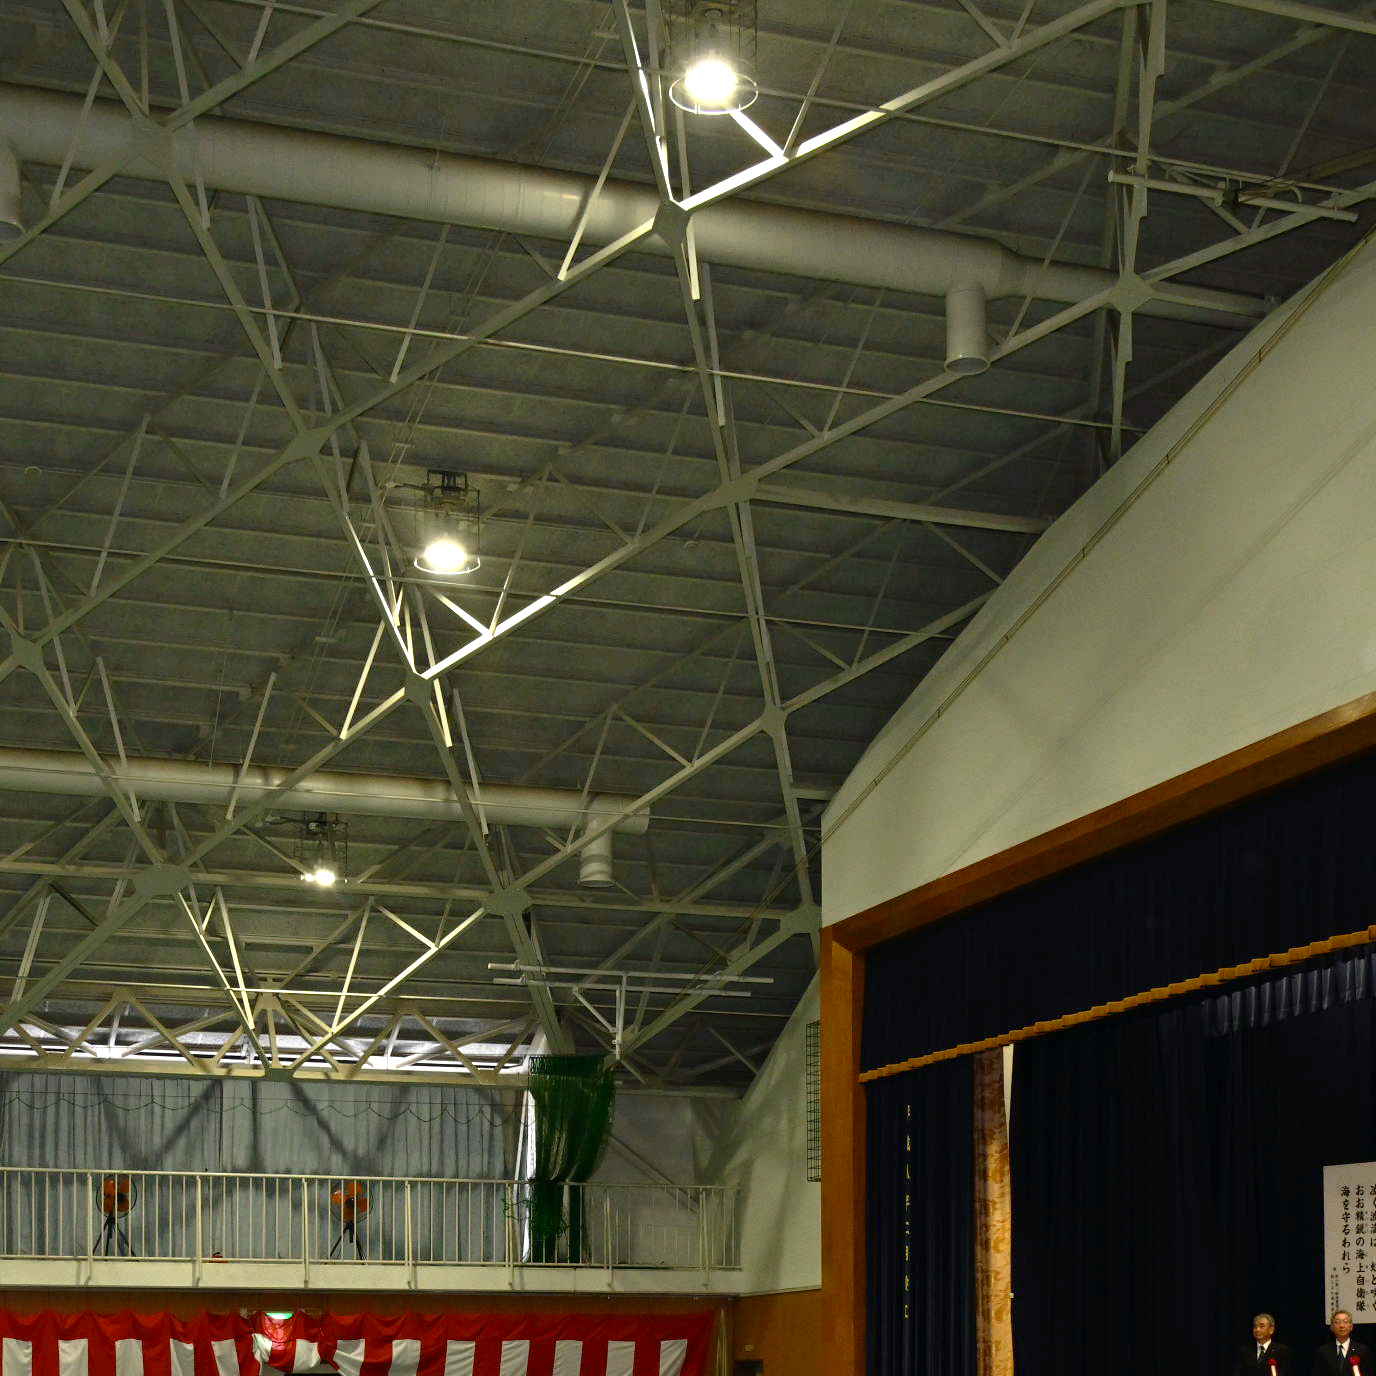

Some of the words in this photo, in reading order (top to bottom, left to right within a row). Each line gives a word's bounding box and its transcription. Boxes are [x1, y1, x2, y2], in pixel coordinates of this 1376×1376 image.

[1340, 1186, 1350, 1274] 海を守るわれら
